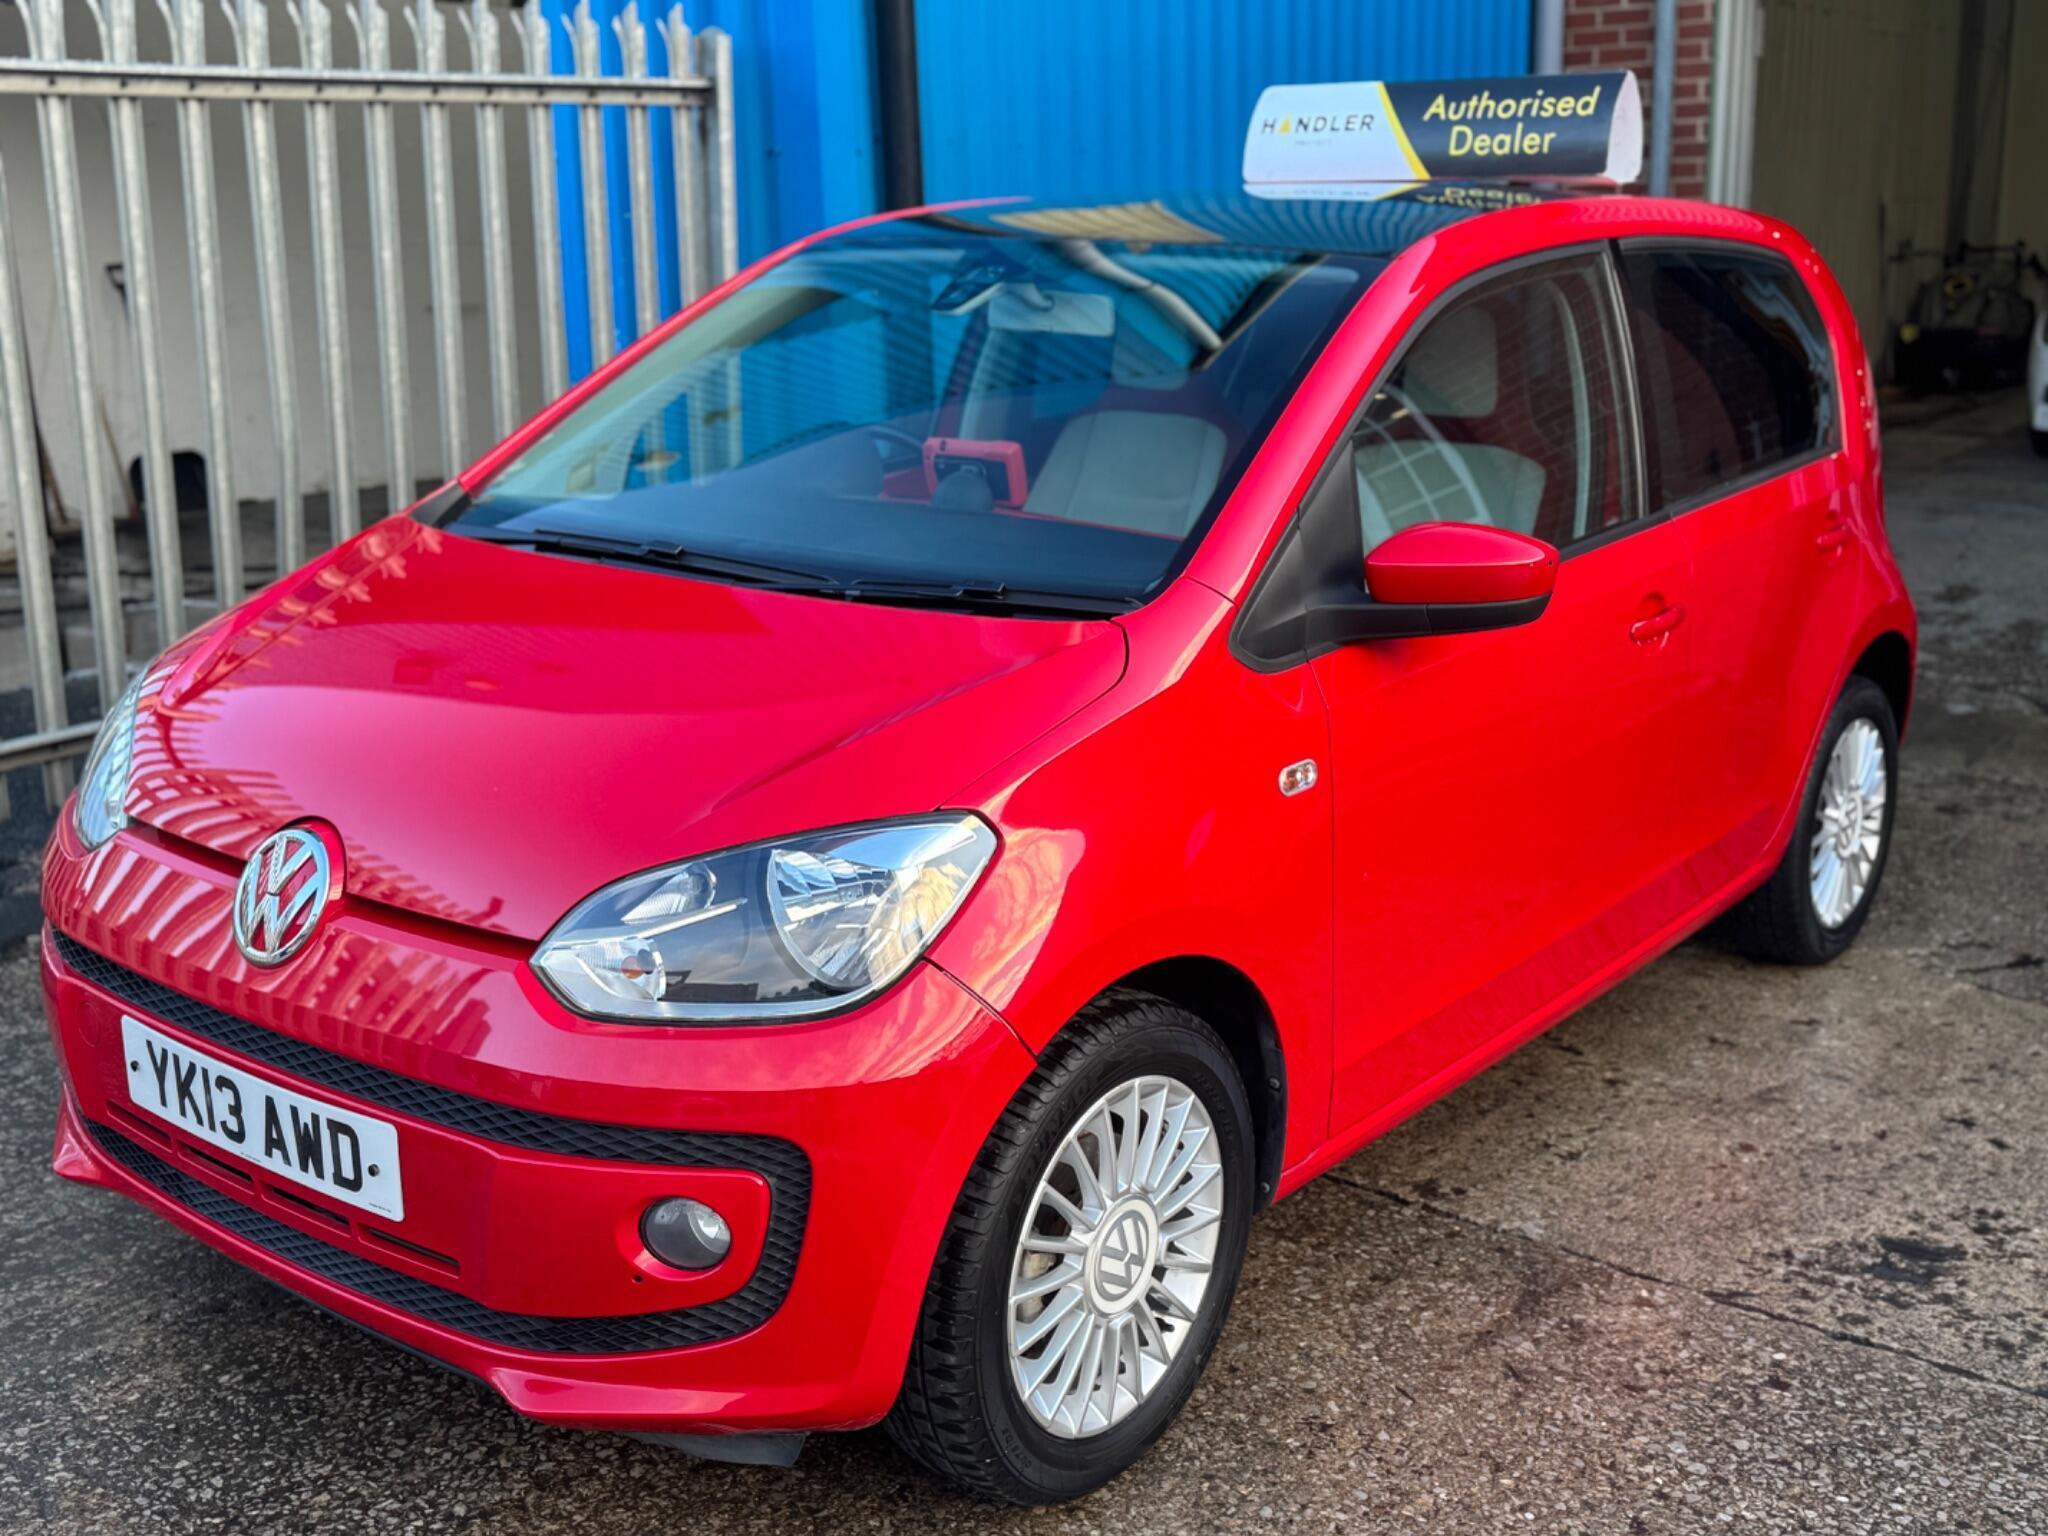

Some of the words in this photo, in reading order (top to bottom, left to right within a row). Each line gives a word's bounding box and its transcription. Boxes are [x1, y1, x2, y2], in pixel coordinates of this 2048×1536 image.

[1422, 85, 1602, 122] Authorised
[1448, 121, 1557, 157] Dealer
[145, 1038, 247, 1145] YK13
[264, 1094, 364, 1194] AWD
